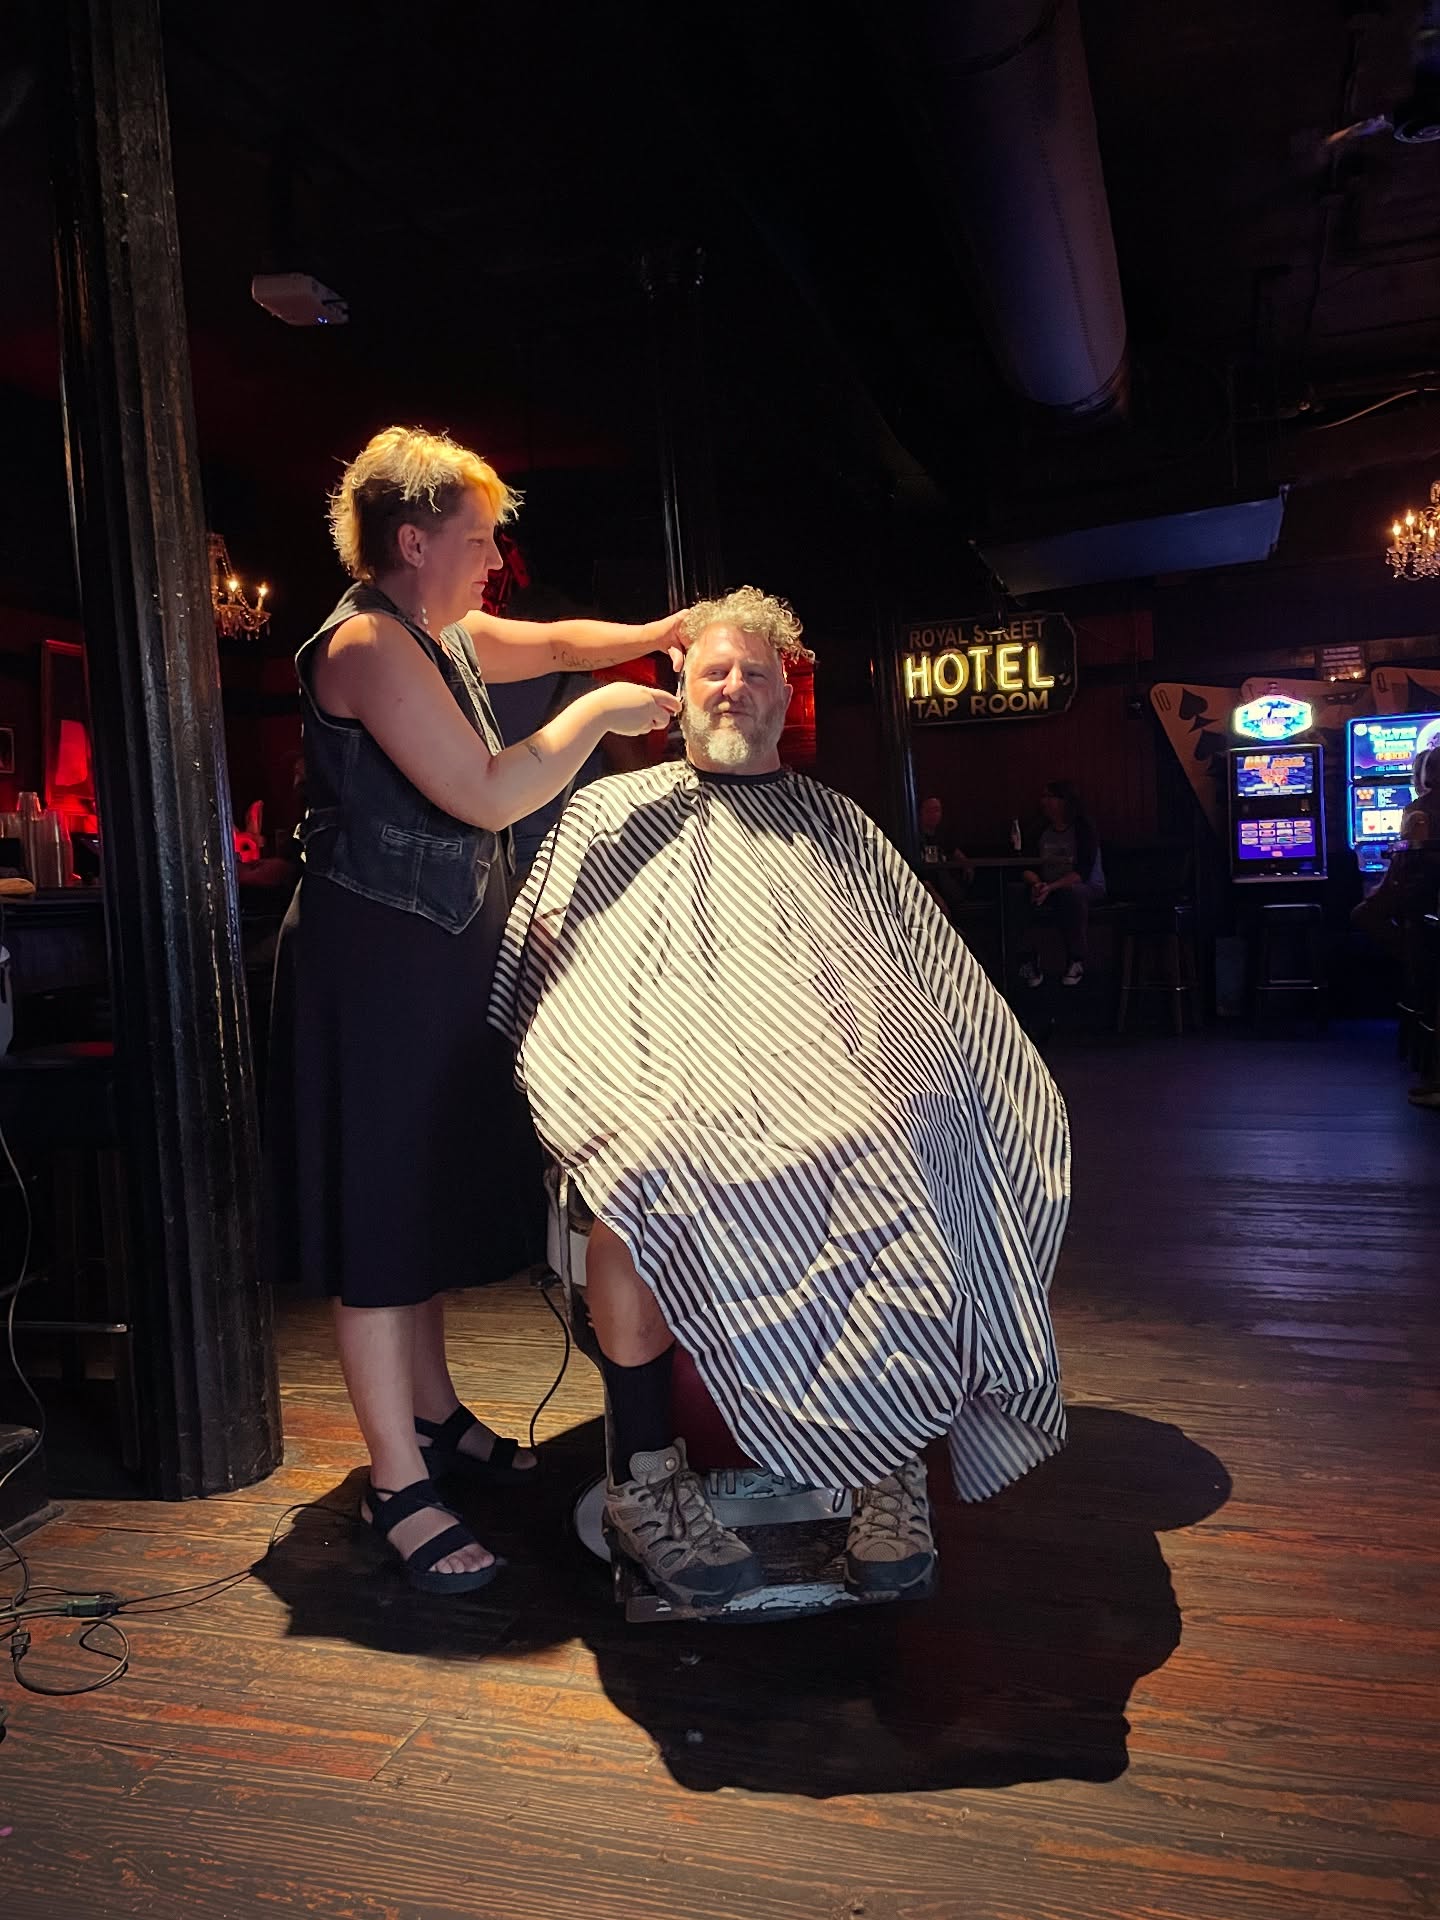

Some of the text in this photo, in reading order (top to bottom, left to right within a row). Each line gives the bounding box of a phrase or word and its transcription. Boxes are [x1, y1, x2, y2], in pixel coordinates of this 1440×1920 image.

[910, 624, 968, 649] ROYAL
[903, 642, 1055, 698] HOTEL
[912, 690, 1048, 719] TAP ROOM
[1153, 689, 1172, 712] 10
